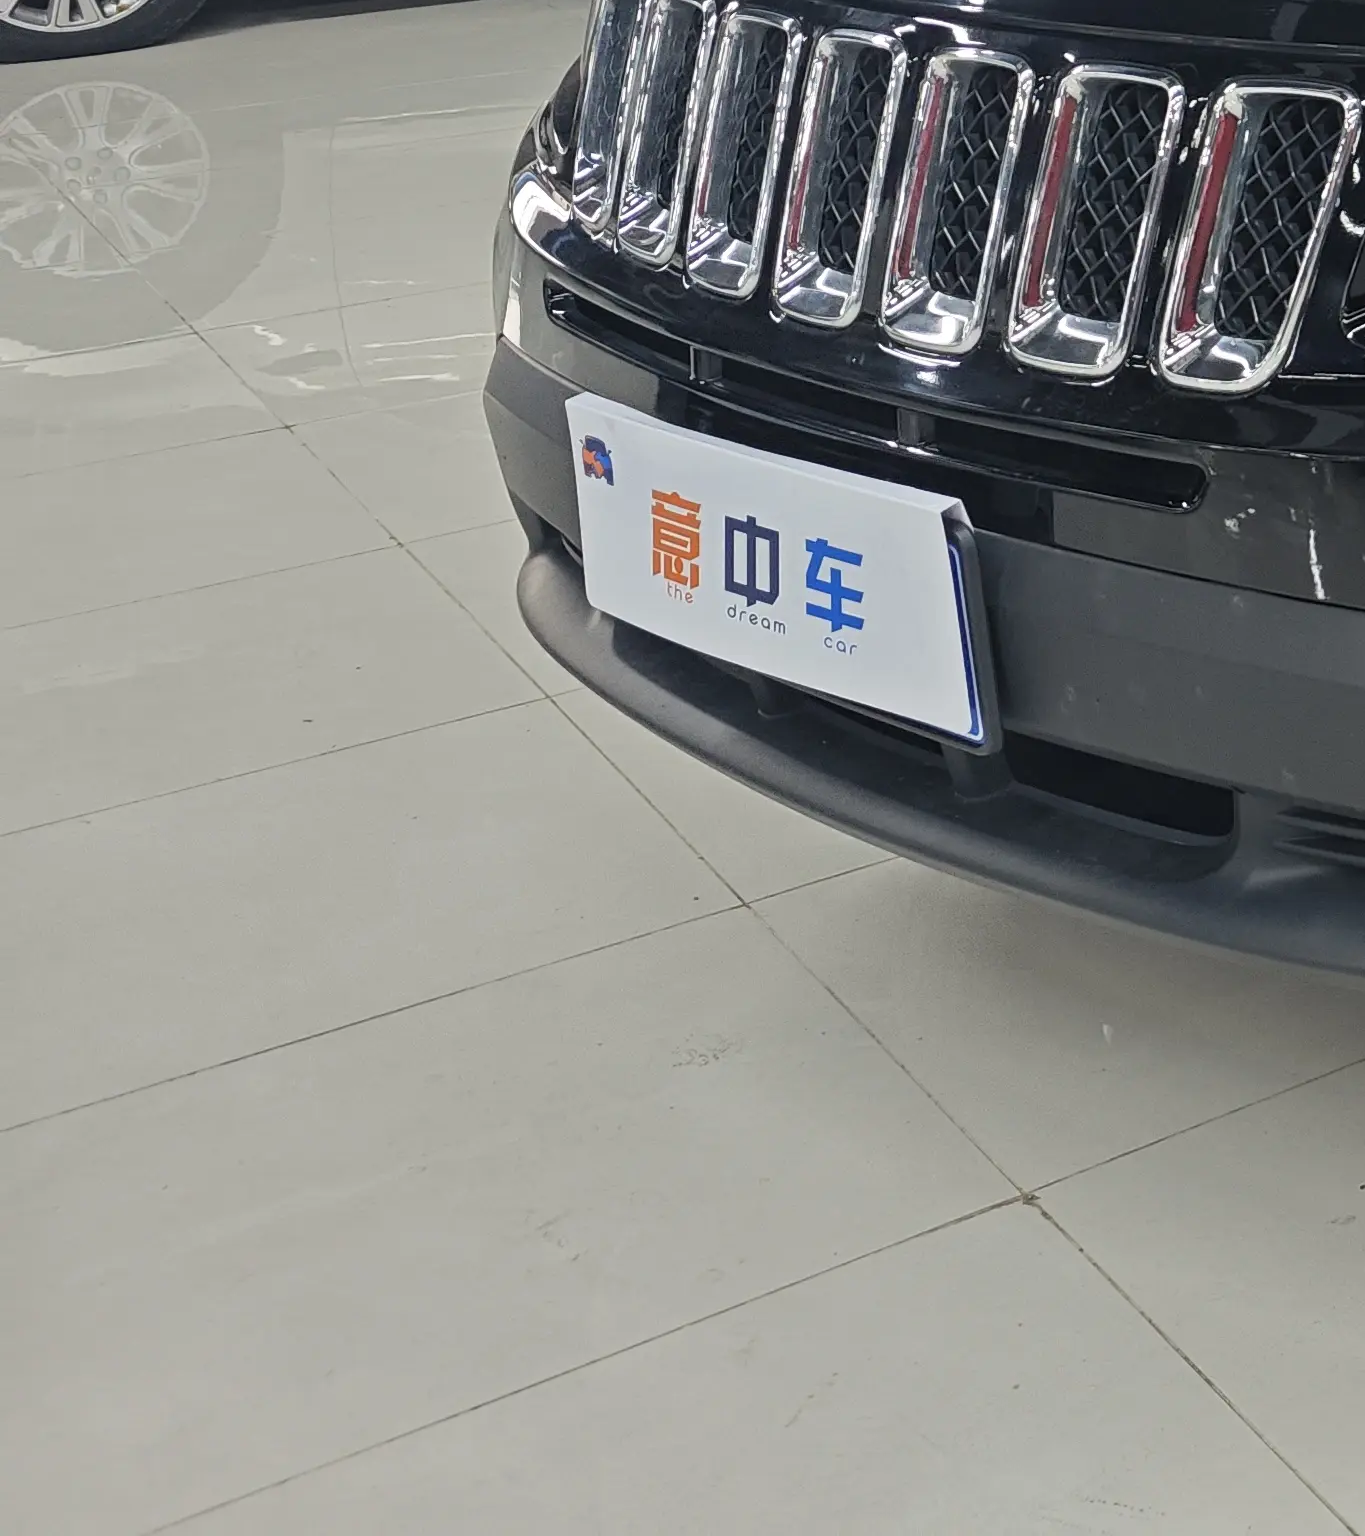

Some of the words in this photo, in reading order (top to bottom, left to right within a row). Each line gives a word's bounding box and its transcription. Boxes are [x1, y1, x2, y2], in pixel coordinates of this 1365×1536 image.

[651, 489, 865, 633] 意中车
[667, 583, 694, 604] the
[726, 604, 787, 635] dream
[823, 636, 858, 656] car
